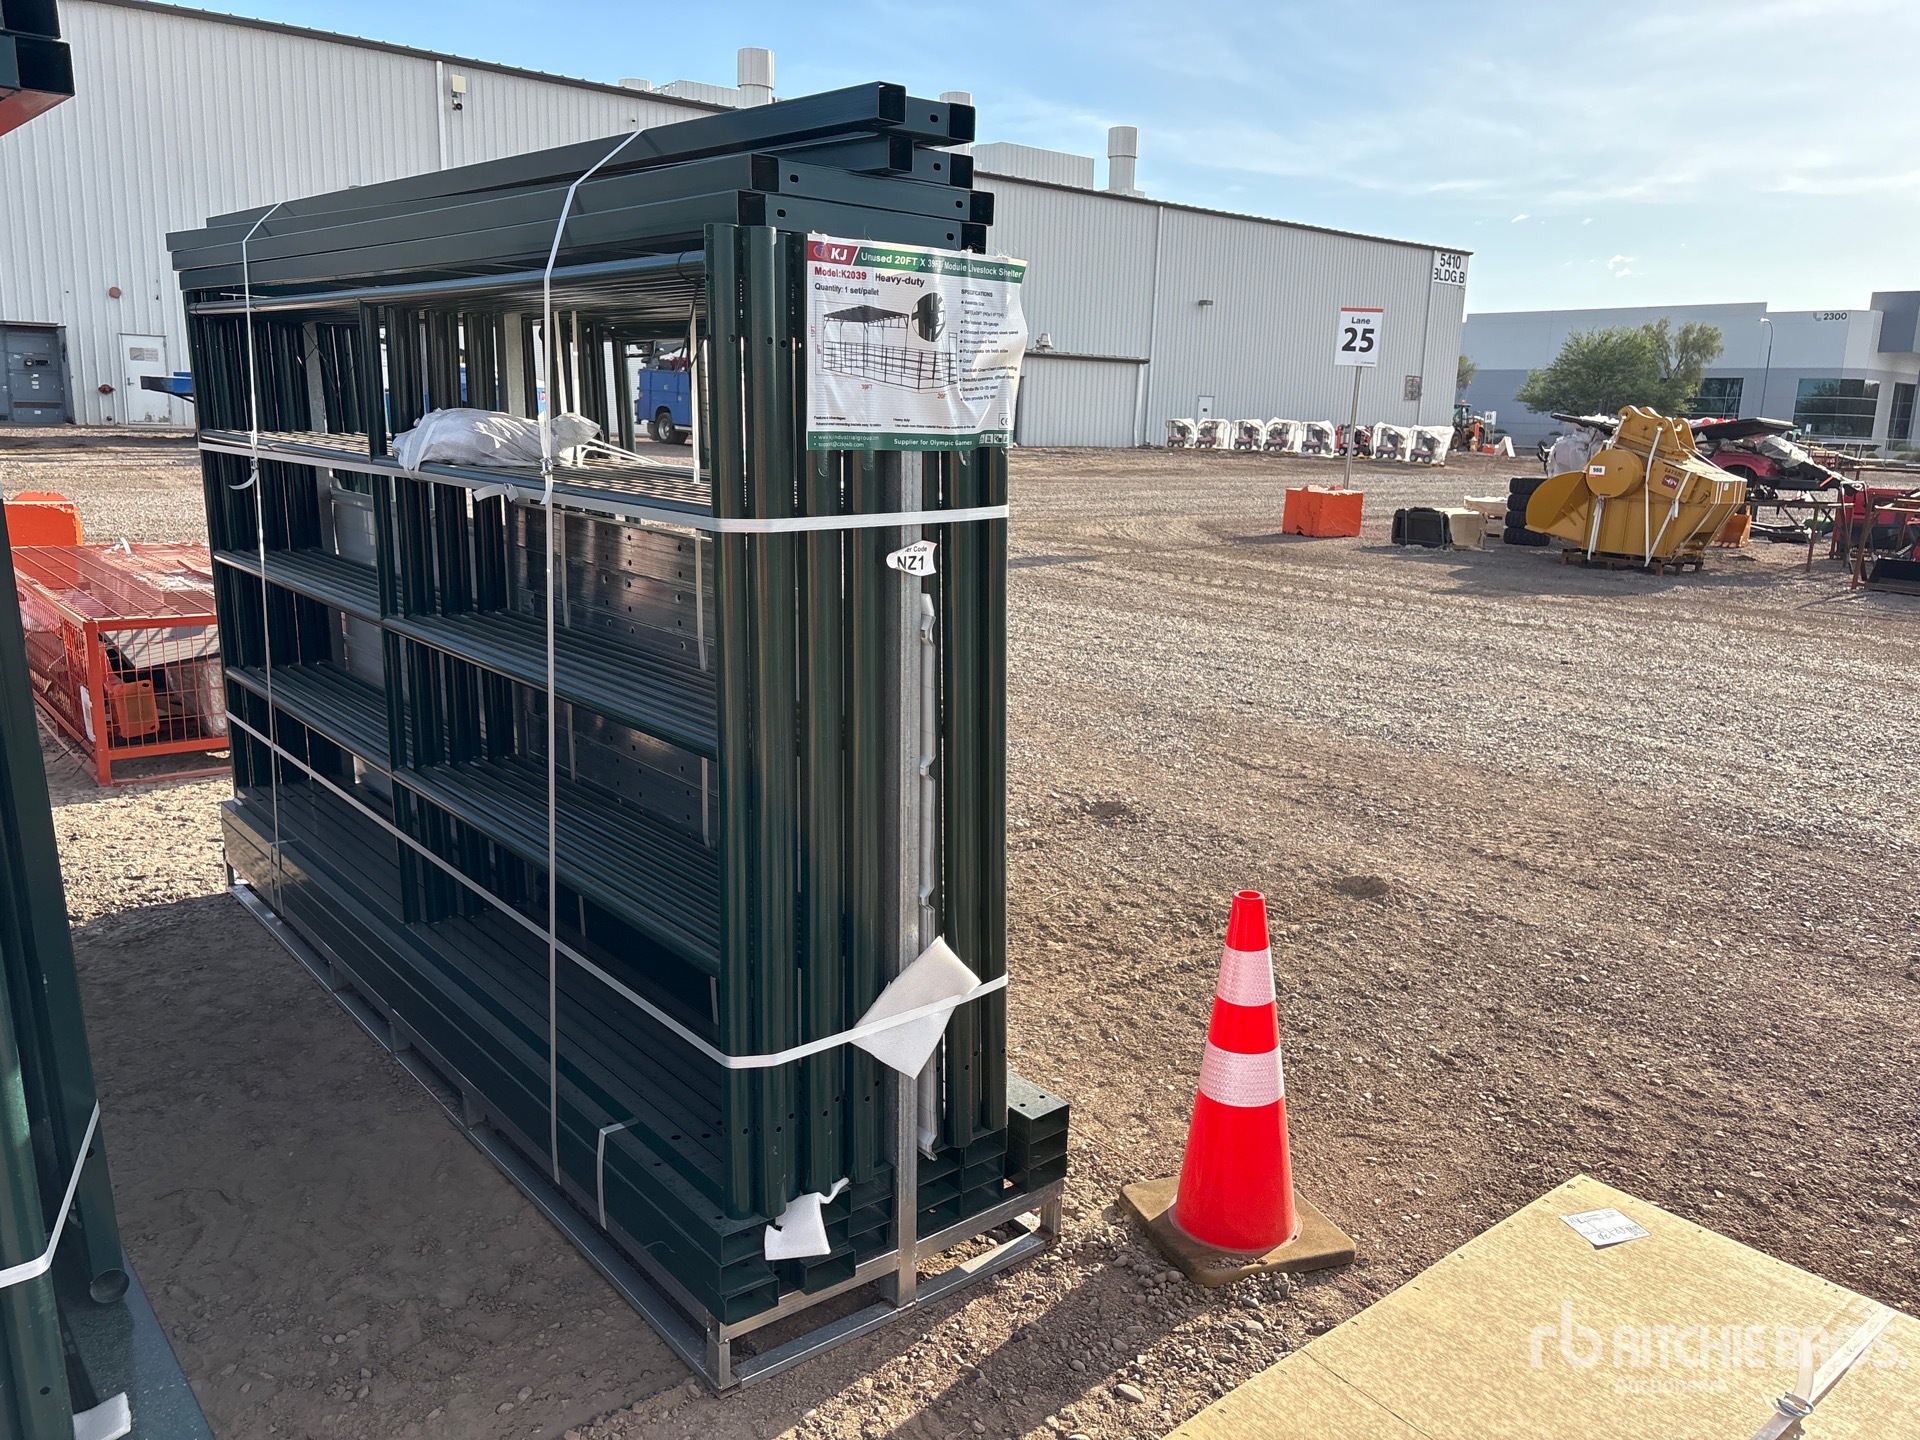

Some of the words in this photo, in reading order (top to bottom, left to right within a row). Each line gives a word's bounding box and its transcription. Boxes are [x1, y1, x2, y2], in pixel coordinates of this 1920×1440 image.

[830, 247, 848, 261] KJ
[861, 251, 892, 264] Unused
[894, 255, 918, 266] 20FT
[944, 261, 967, 272] Module
[968, 264, 997, 276] Livestock
[998, 267, 1023, 278] Shelter
[1440, 253, 1461, 270] 5410
[814, 266, 867, 281] Model:K2039
[875, 272, 925, 288] Heavy-duty
[1459, 271, 1465, 284] B
[814, 282, 844, 294] Quantity:
[849, 287, 880, 297] set/pallet
[1351, 316, 1371, 325] Lane
[1823, 312, 1848, 321] 2300
[1341, 327, 1375, 353] 25
[893, 438, 918, 446] Supplier
[929, 439, 954, 447] Olympic
[913, 545, 927, 553] Code
[897, 555, 924, 571] NZ1
